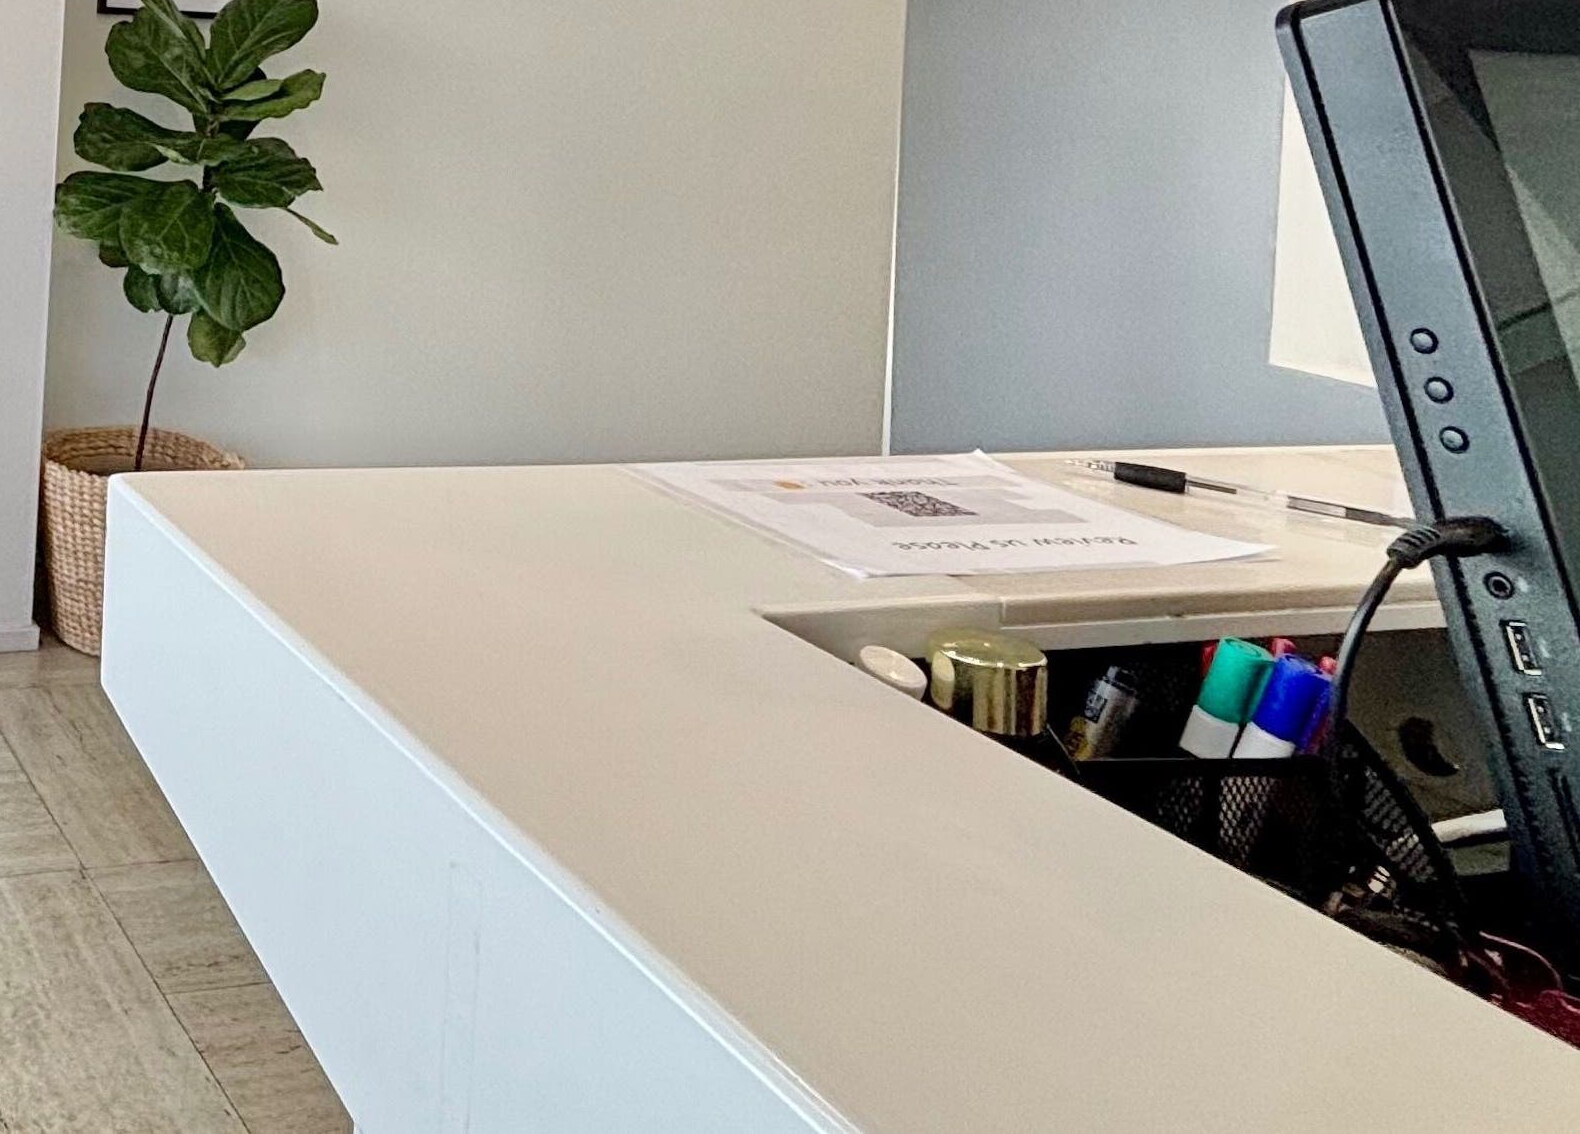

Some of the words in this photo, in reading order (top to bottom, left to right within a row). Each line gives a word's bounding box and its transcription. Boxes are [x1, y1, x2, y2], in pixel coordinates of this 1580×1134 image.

[892, 540, 990, 552] Please
[990, 538, 1028, 549] us
[1033, 536, 1139, 548] Review
